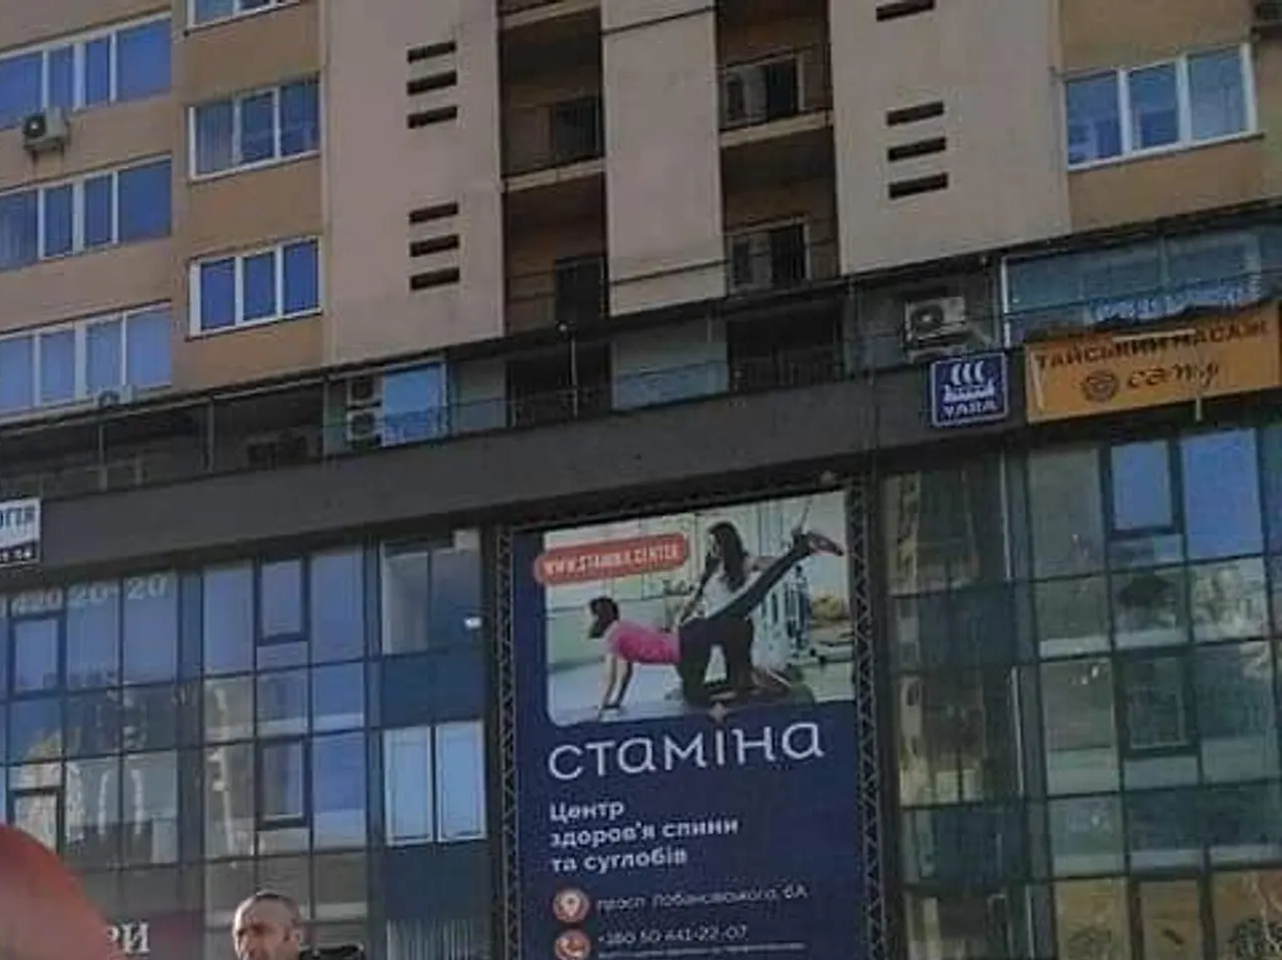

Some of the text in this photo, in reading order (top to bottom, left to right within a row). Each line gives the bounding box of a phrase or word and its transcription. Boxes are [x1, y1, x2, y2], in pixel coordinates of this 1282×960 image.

[549, 801, 625, 823] Центр
[662, 818, 739, 838] спини
[551, 846, 688, 874] та суглобів
